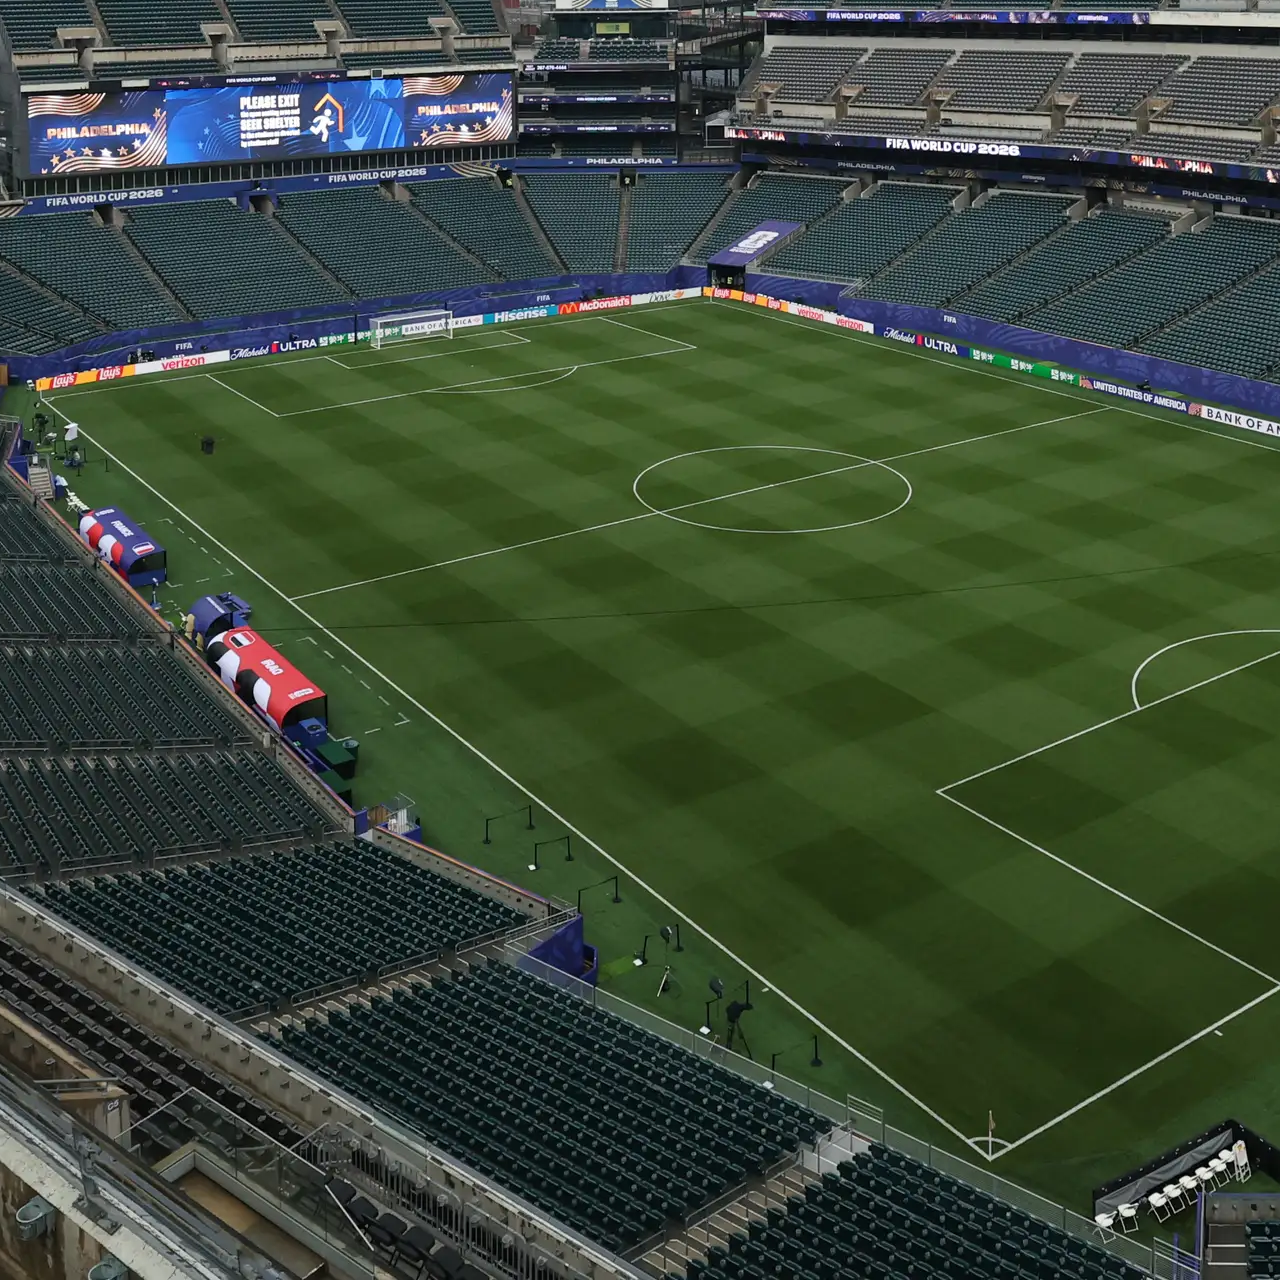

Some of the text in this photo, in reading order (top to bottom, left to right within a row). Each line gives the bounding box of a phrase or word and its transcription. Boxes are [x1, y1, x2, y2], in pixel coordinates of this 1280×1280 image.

[827, 12, 901, 21] FIFA WORLD CUP 2026
[239, 93, 300, 110] PLEASE EXIT
[418, 102, 499, 116] PHILADELPHIA
[46, 123, 150, 140] PHILADELPHIA
[240, 116, 301, 131] SEEK SHELTER
[886, 138, 1021, 157] FIFA WORLD CUP 2026
[586, 157, 664, 165] PHILADELPHIA
[837, 160, 896, 172] PHILADELPHIA
[329, 167, 427, 184] FIFA WORLD CUP 2026
[46, 188, 164, 207] FIFA WORLD CUP 2026
[1182, 189, 1248, 204] PHILADELPHIA
[578, 296, 631, 312] McDonald's
[494, 305, 548, 323] Hisense
[797, 307, 825, 321] verizon
[943, 315, 957, 324] FIFA
[404, 322, 425, 333] BANK
[427, 321, 437, 330] OF
[835, 316, 864, 331] verizon
[176, 342, 193, 351] FIFA
[883, 326, 958, 356] Michelob ULTRA
[231, 338, 318, 361] Michelob ULTRA
[161, 355, 206, 371] verizon
[1093, 380, 1187, 412] UNITED STATES OF AMERICA
[1207, 407, 1241, 426] BANK
[1246, 417, 1263, 430] OF
[110, 519, 135, 538] FRANCE
[260, 658, 284, 676] IRAQ
